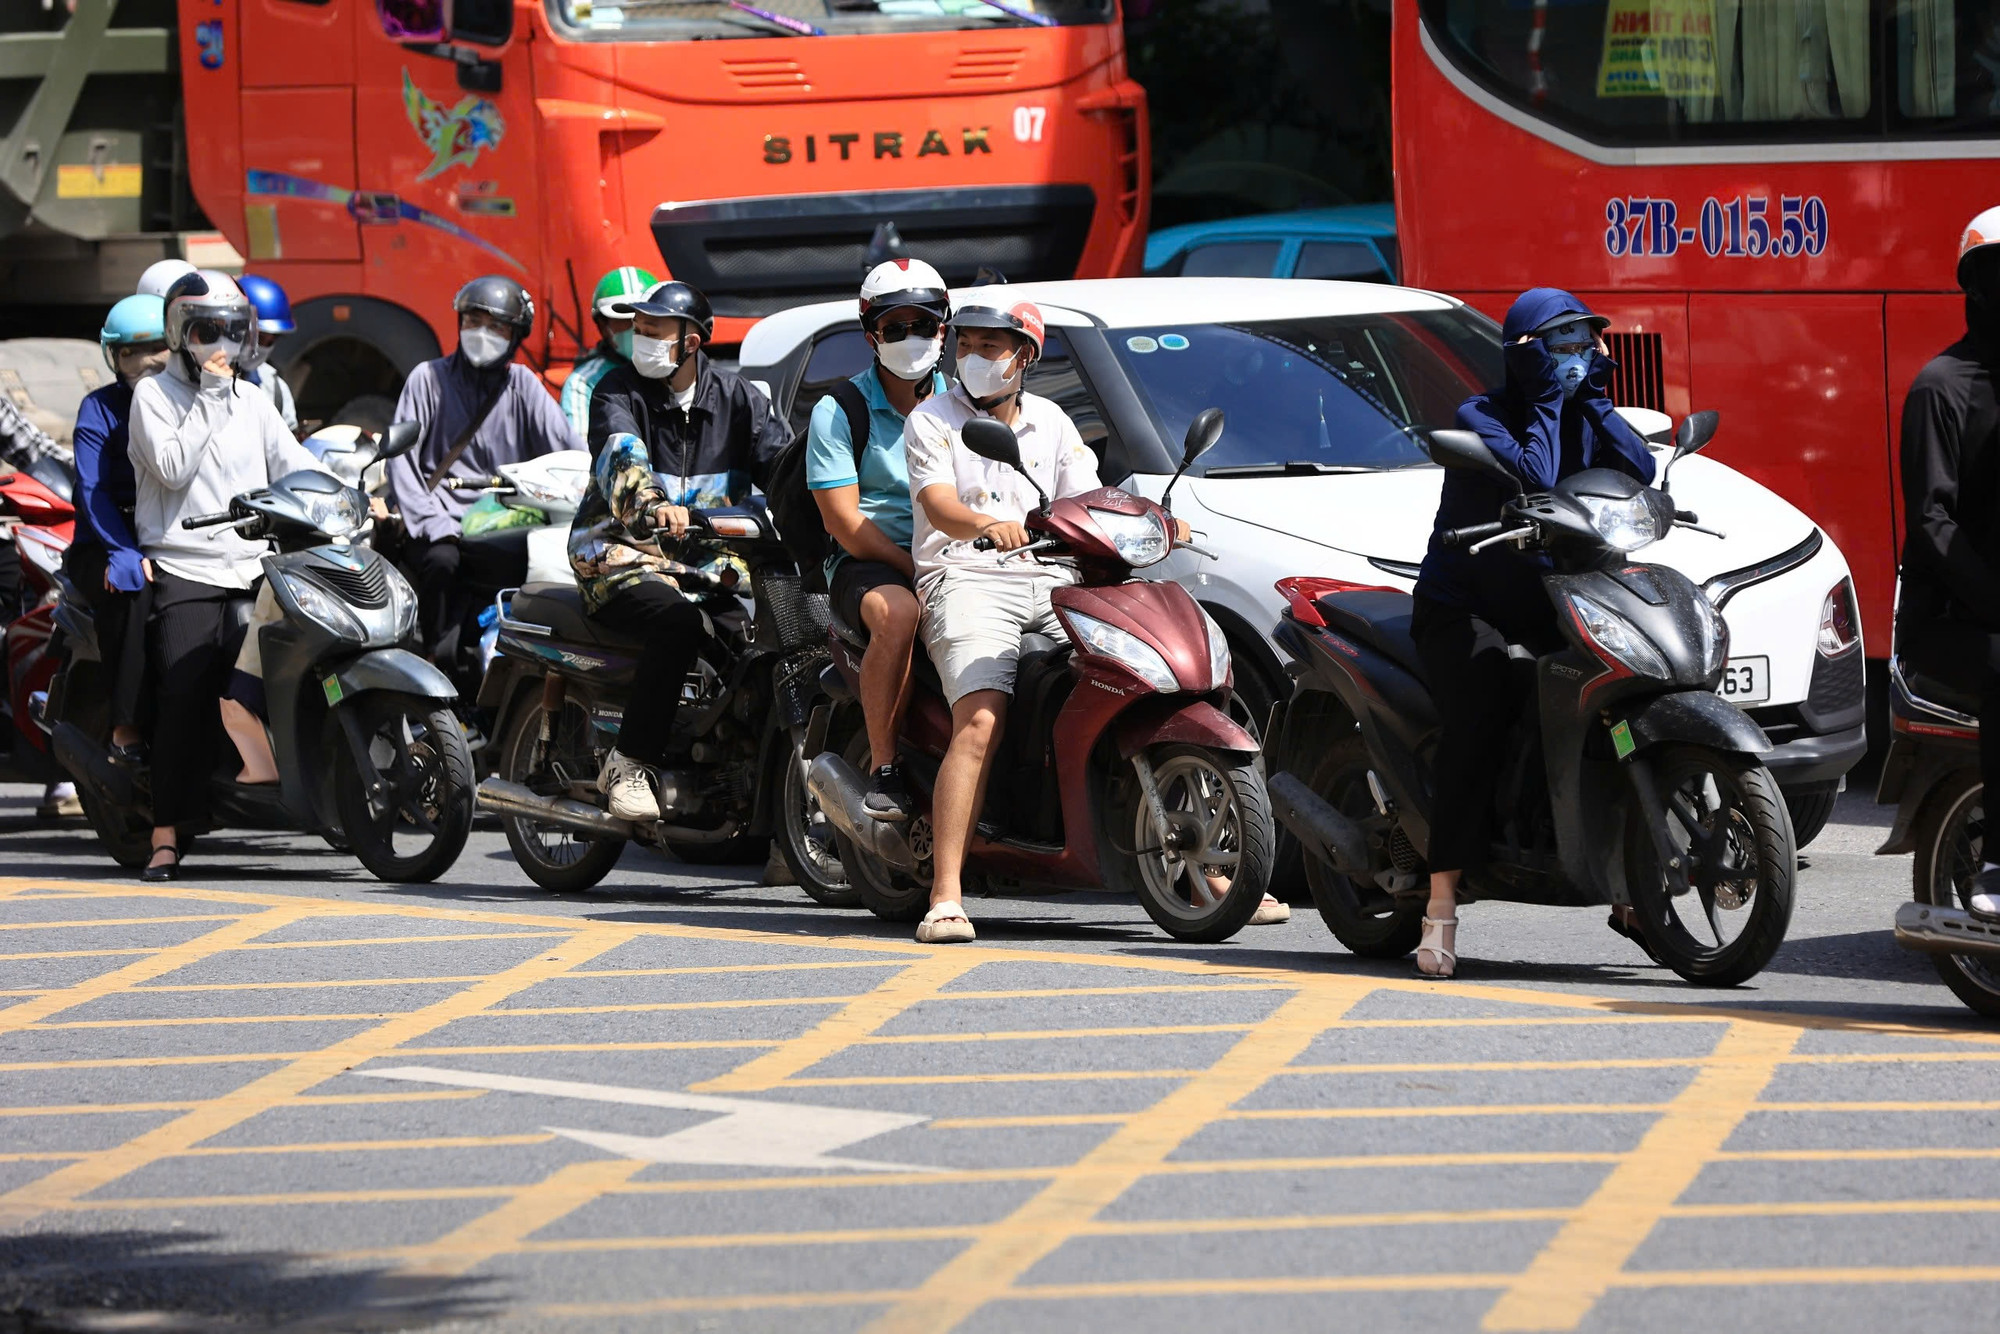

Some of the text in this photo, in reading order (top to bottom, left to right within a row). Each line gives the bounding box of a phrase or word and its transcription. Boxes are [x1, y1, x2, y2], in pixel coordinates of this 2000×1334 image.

[1013, 106, 1046, 142] 07
[763, 126, 992, 165] SITRAK
[1605, 194, 1829, 258] 37B-015.59
[559, 650, 607, 668] Dream
[843, 650, 862, 673] VIS
[1550, 662, 1584, 677] SPORTY
[1090, 679, 1126, 696] HONDA
[598, 708, 624, 719] HONDA
